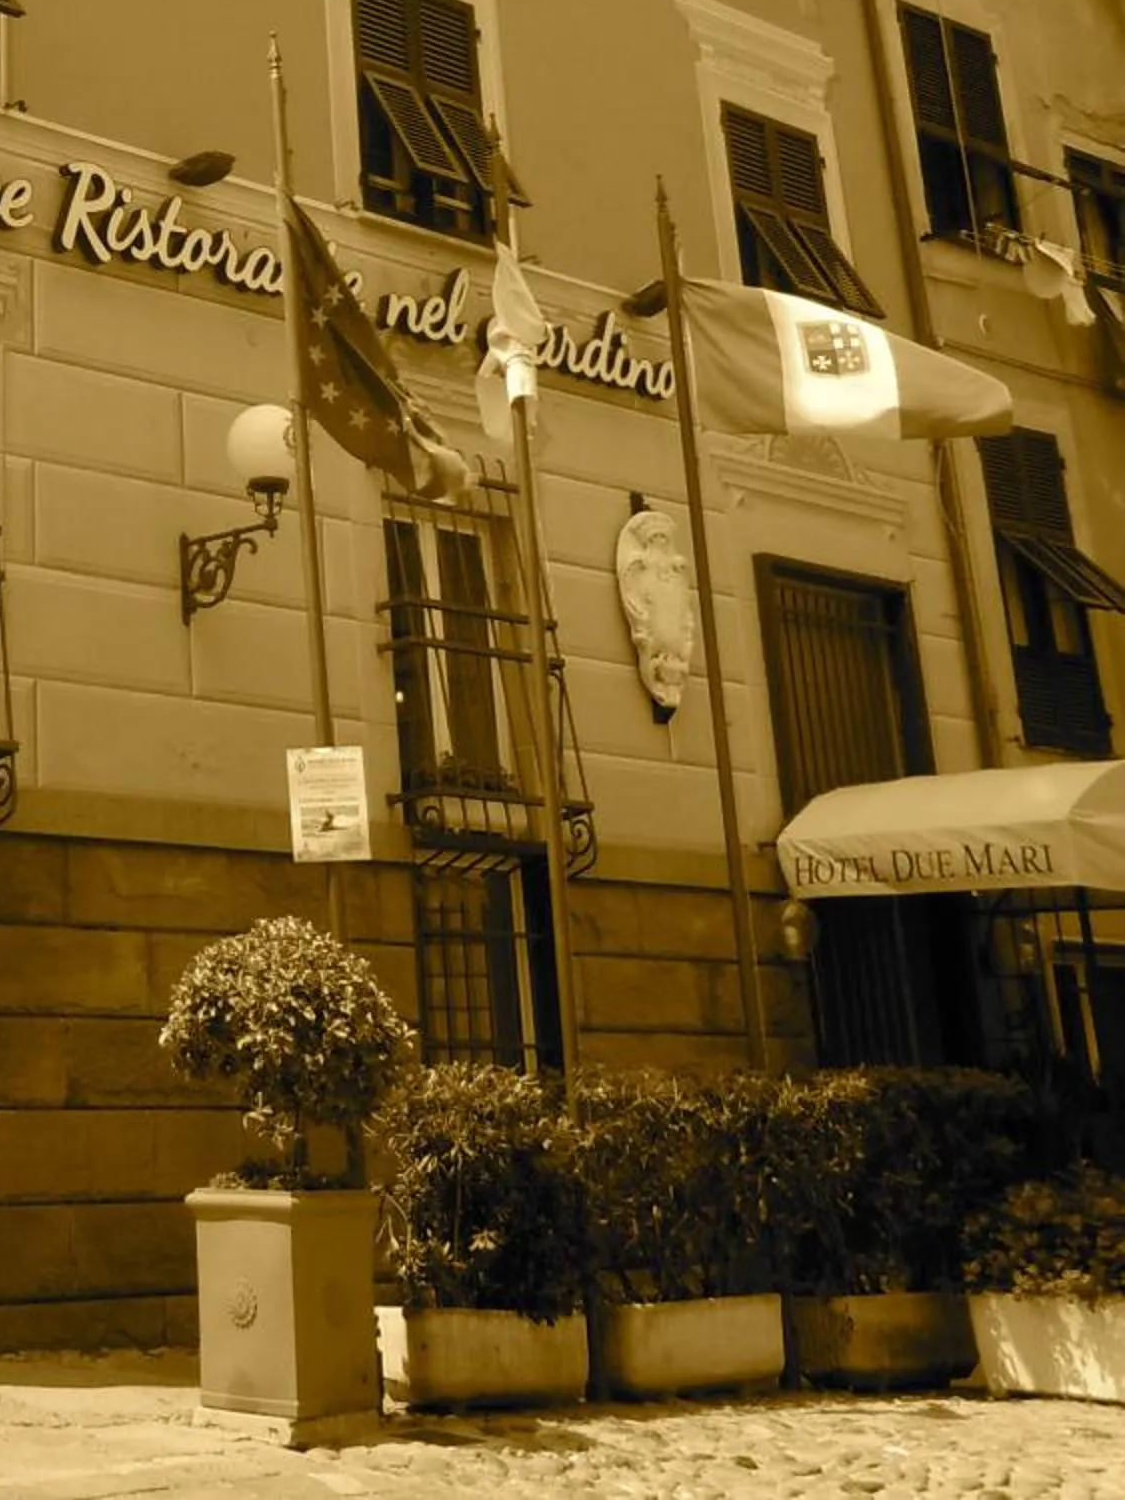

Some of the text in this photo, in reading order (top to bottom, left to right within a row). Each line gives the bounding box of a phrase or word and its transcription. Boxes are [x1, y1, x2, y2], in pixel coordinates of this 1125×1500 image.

[385, 266, 469, 344] nel
[487, 310, 677, 400] ardino
[794, 843, 1055, 888] HOTEL DUE MARI
